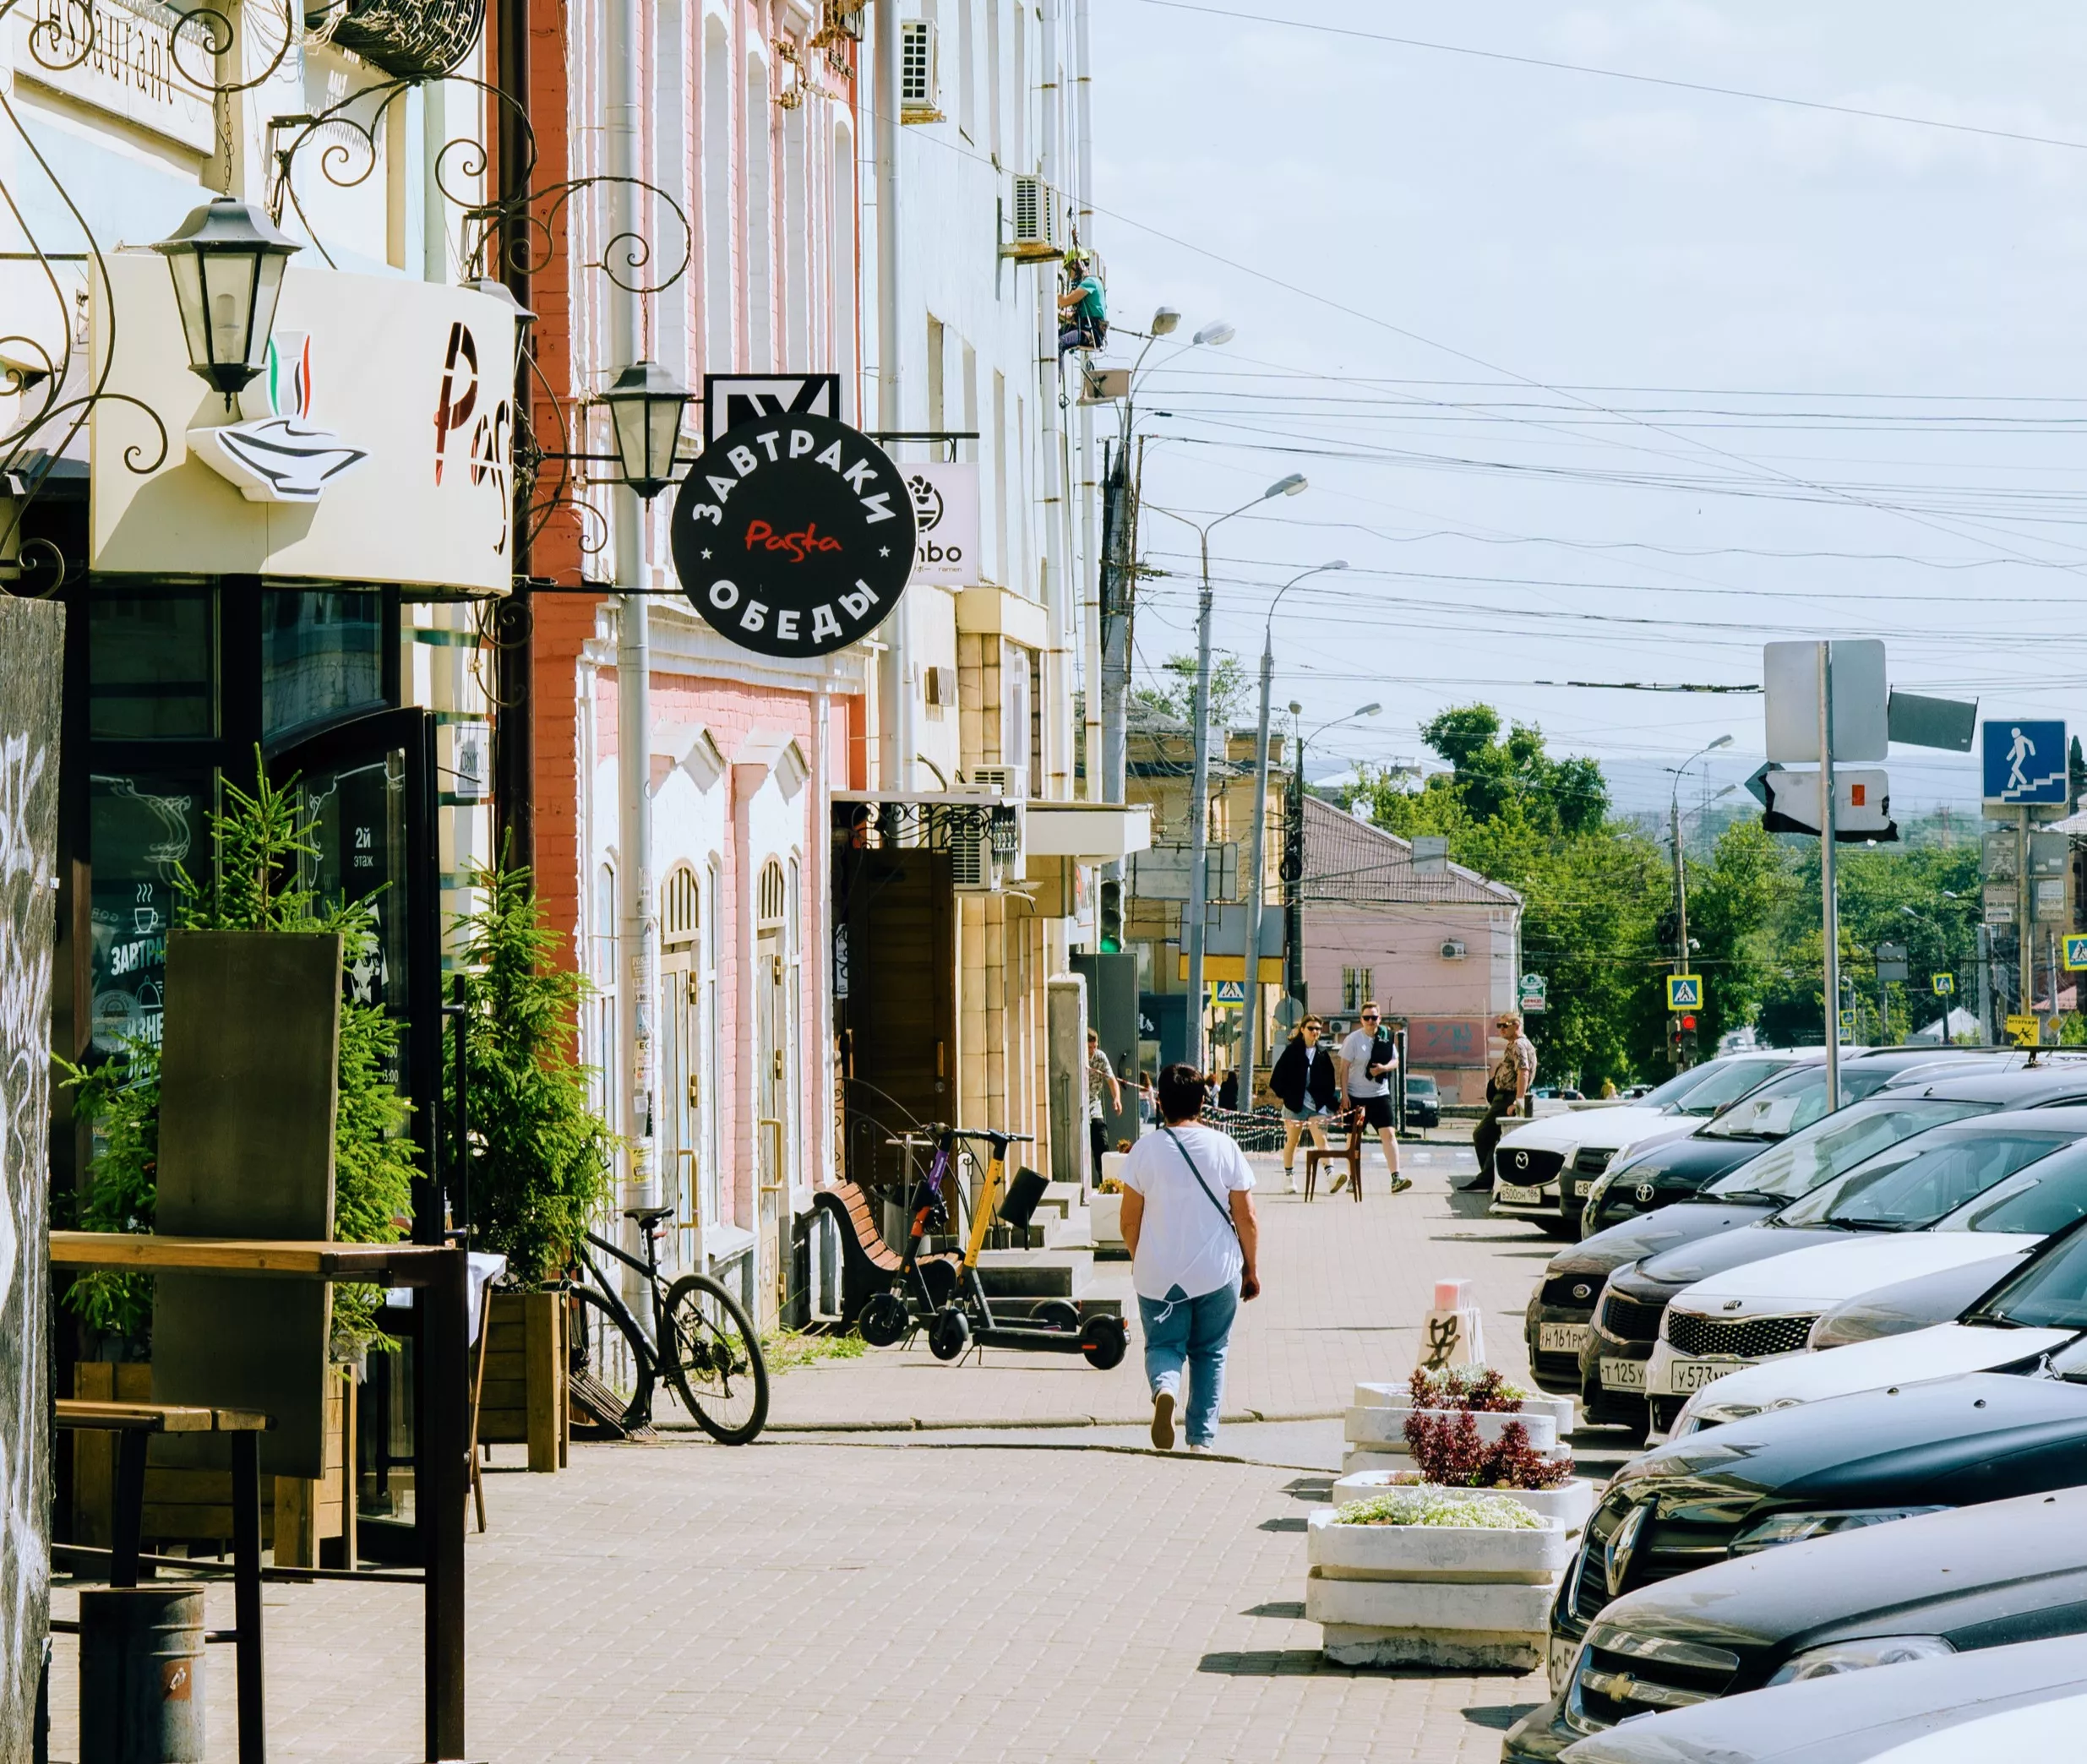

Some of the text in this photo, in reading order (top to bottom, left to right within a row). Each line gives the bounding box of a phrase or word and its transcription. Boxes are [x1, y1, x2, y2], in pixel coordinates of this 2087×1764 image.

[692, 429, 896, 525] ЗАВТРАКИ
[745, 520, 843, 563] Pasta
[709, 579, 880, 644] ОБЕДЫ
[355, 827, 372, 848] 2й
[353, 855, 373, 868] этаж
[111, 936, 166, 976] ЗАВТРА
[1577, 1184, 1591, 1195] С8
